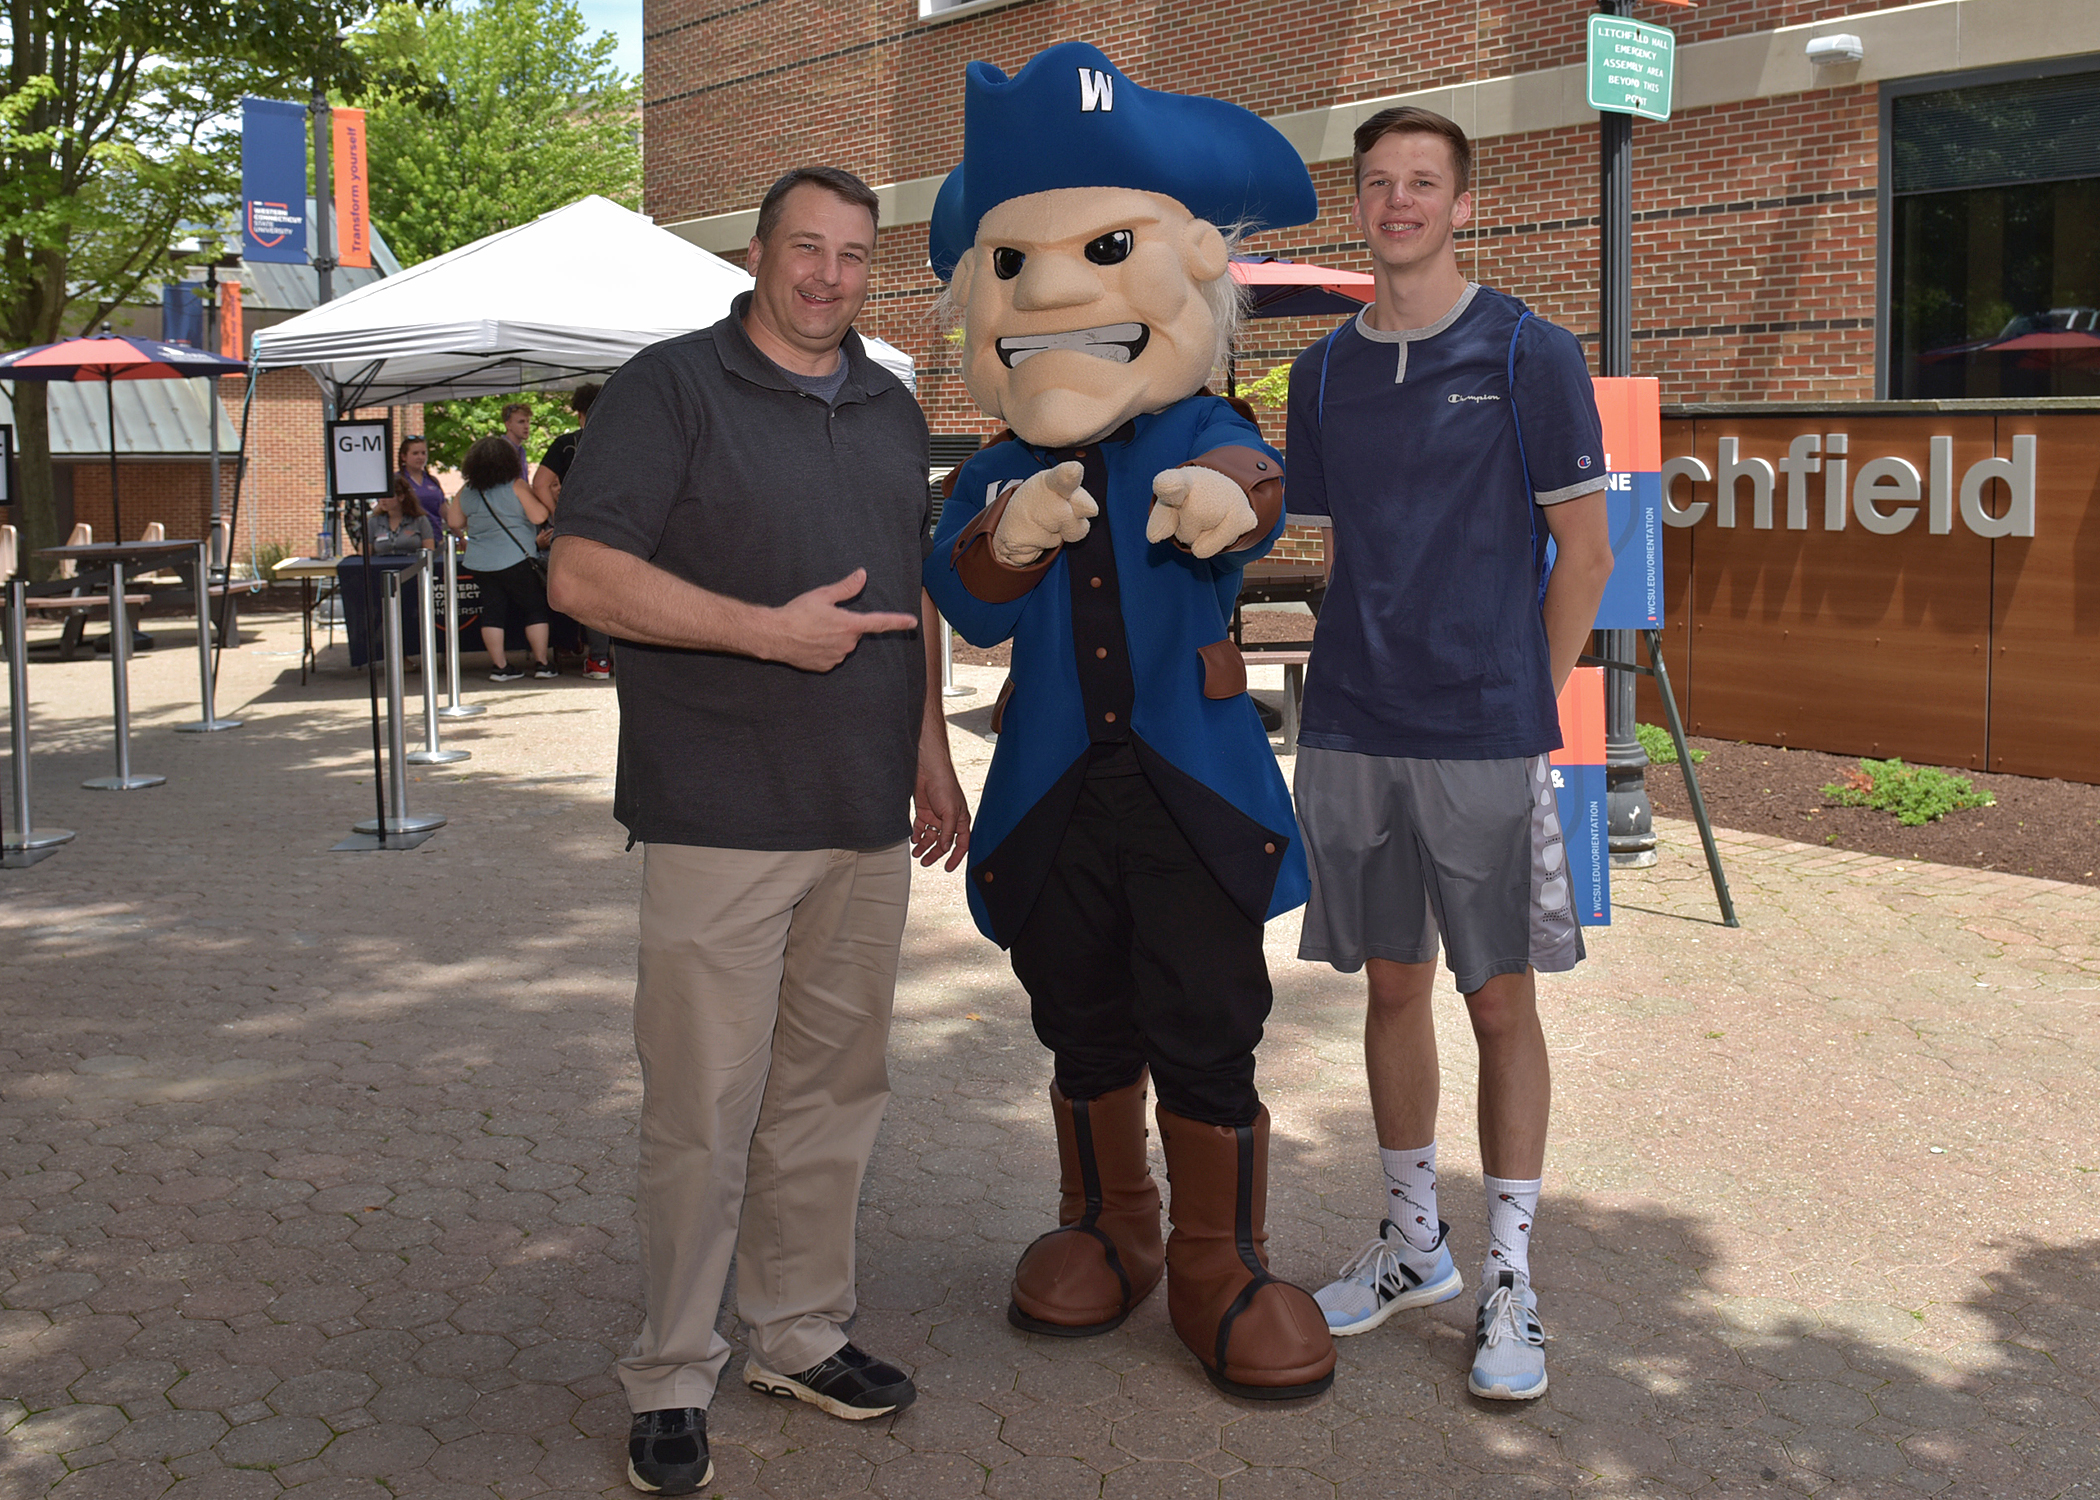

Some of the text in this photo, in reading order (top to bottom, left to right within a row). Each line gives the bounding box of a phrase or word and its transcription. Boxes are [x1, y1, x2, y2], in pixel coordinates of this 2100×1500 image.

[1598, 27, 1668, 50] LITCHFILD HALL
[1615, 44, 1657, 60] EMERGENCY
[1603, 58, 1664, 78] ASSEMBLY AREA
[1077, 67, 1113, 112] W
[1608, 75, 1660, 93] BEYOND THIS
[347, 127, 361, 253] Transform yourself
[1447, 393, 1501, 404] Champion
[338, 435, 382, 453] G-M
[1661, 433, 2037, 539] chfield
[1645, 507, 1656, 615] WCSU.EDU/ORIENTATION
[1590, 801, 1602, 911] WCSU.EDU/ORIENTATION
